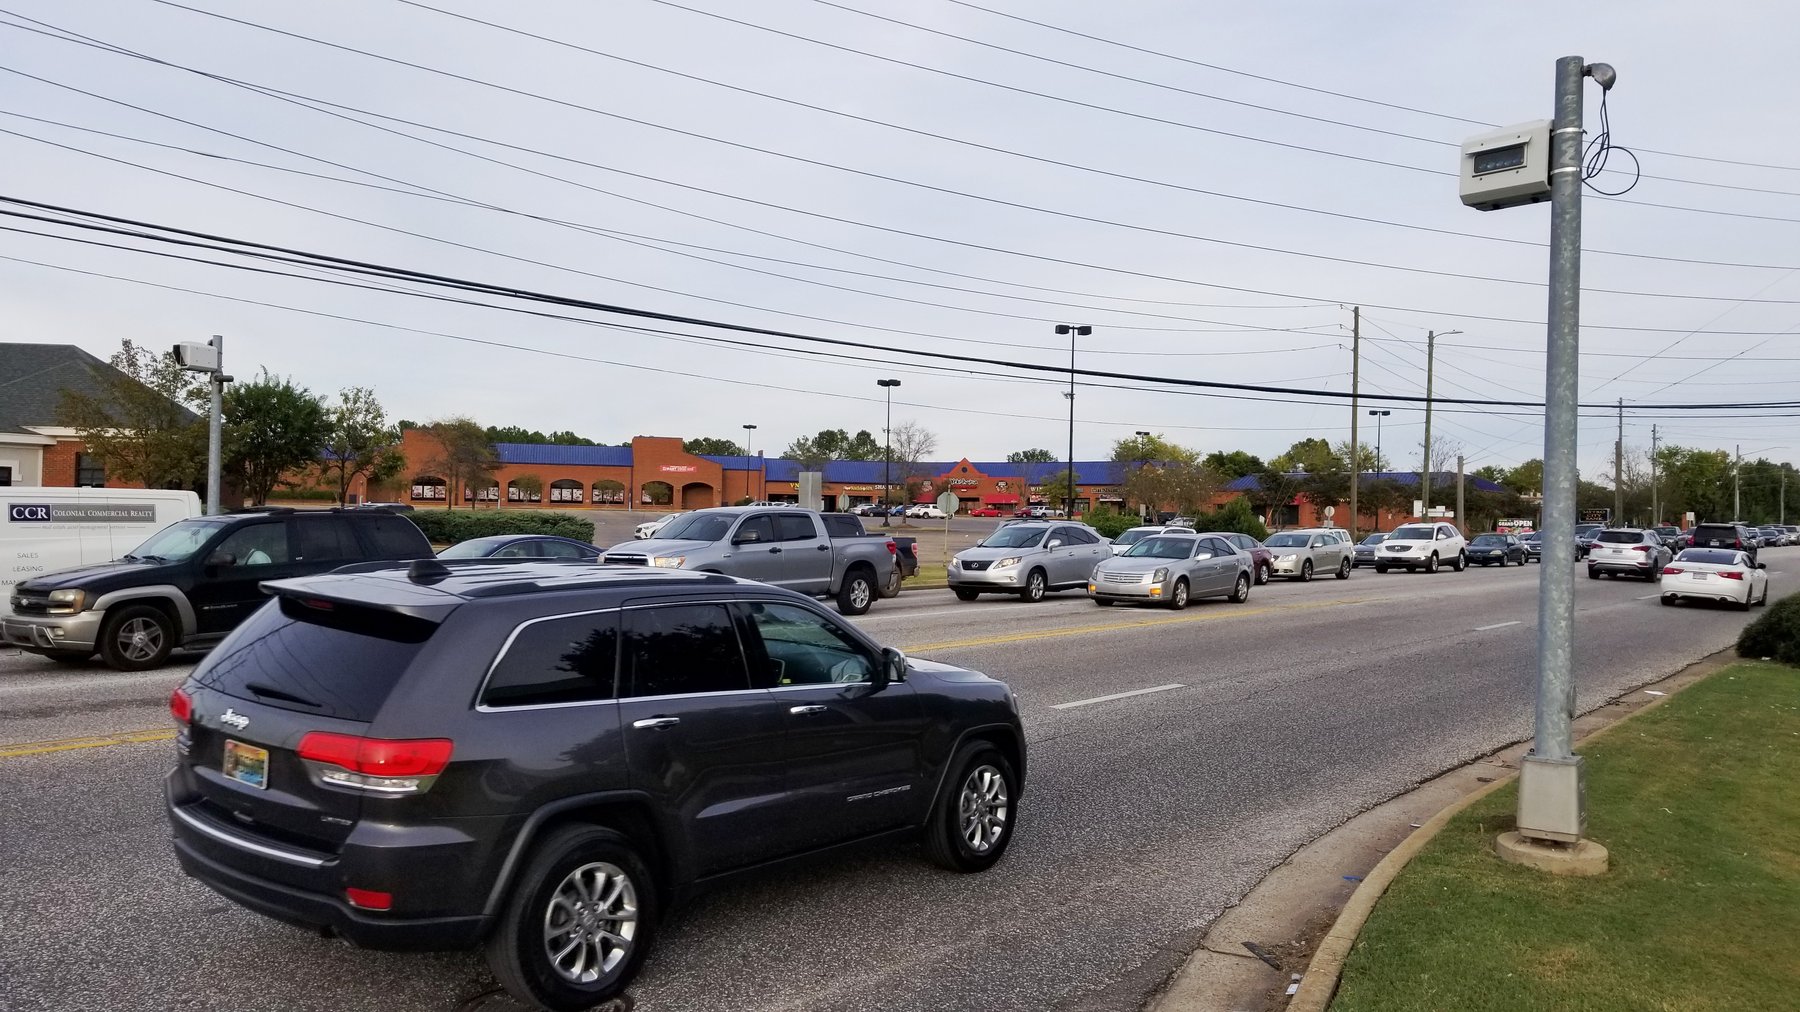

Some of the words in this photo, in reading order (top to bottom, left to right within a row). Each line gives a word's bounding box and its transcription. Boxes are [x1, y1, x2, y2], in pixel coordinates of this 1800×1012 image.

[12, 506, 48, 519] CCR
[52, 509, 85, 517] COLONIAL
[87, 509, 128, 517] COMMERCIAL
[1514, 519, 1533, 527] OPEN
[220, 708, 250, 731] Jeep
